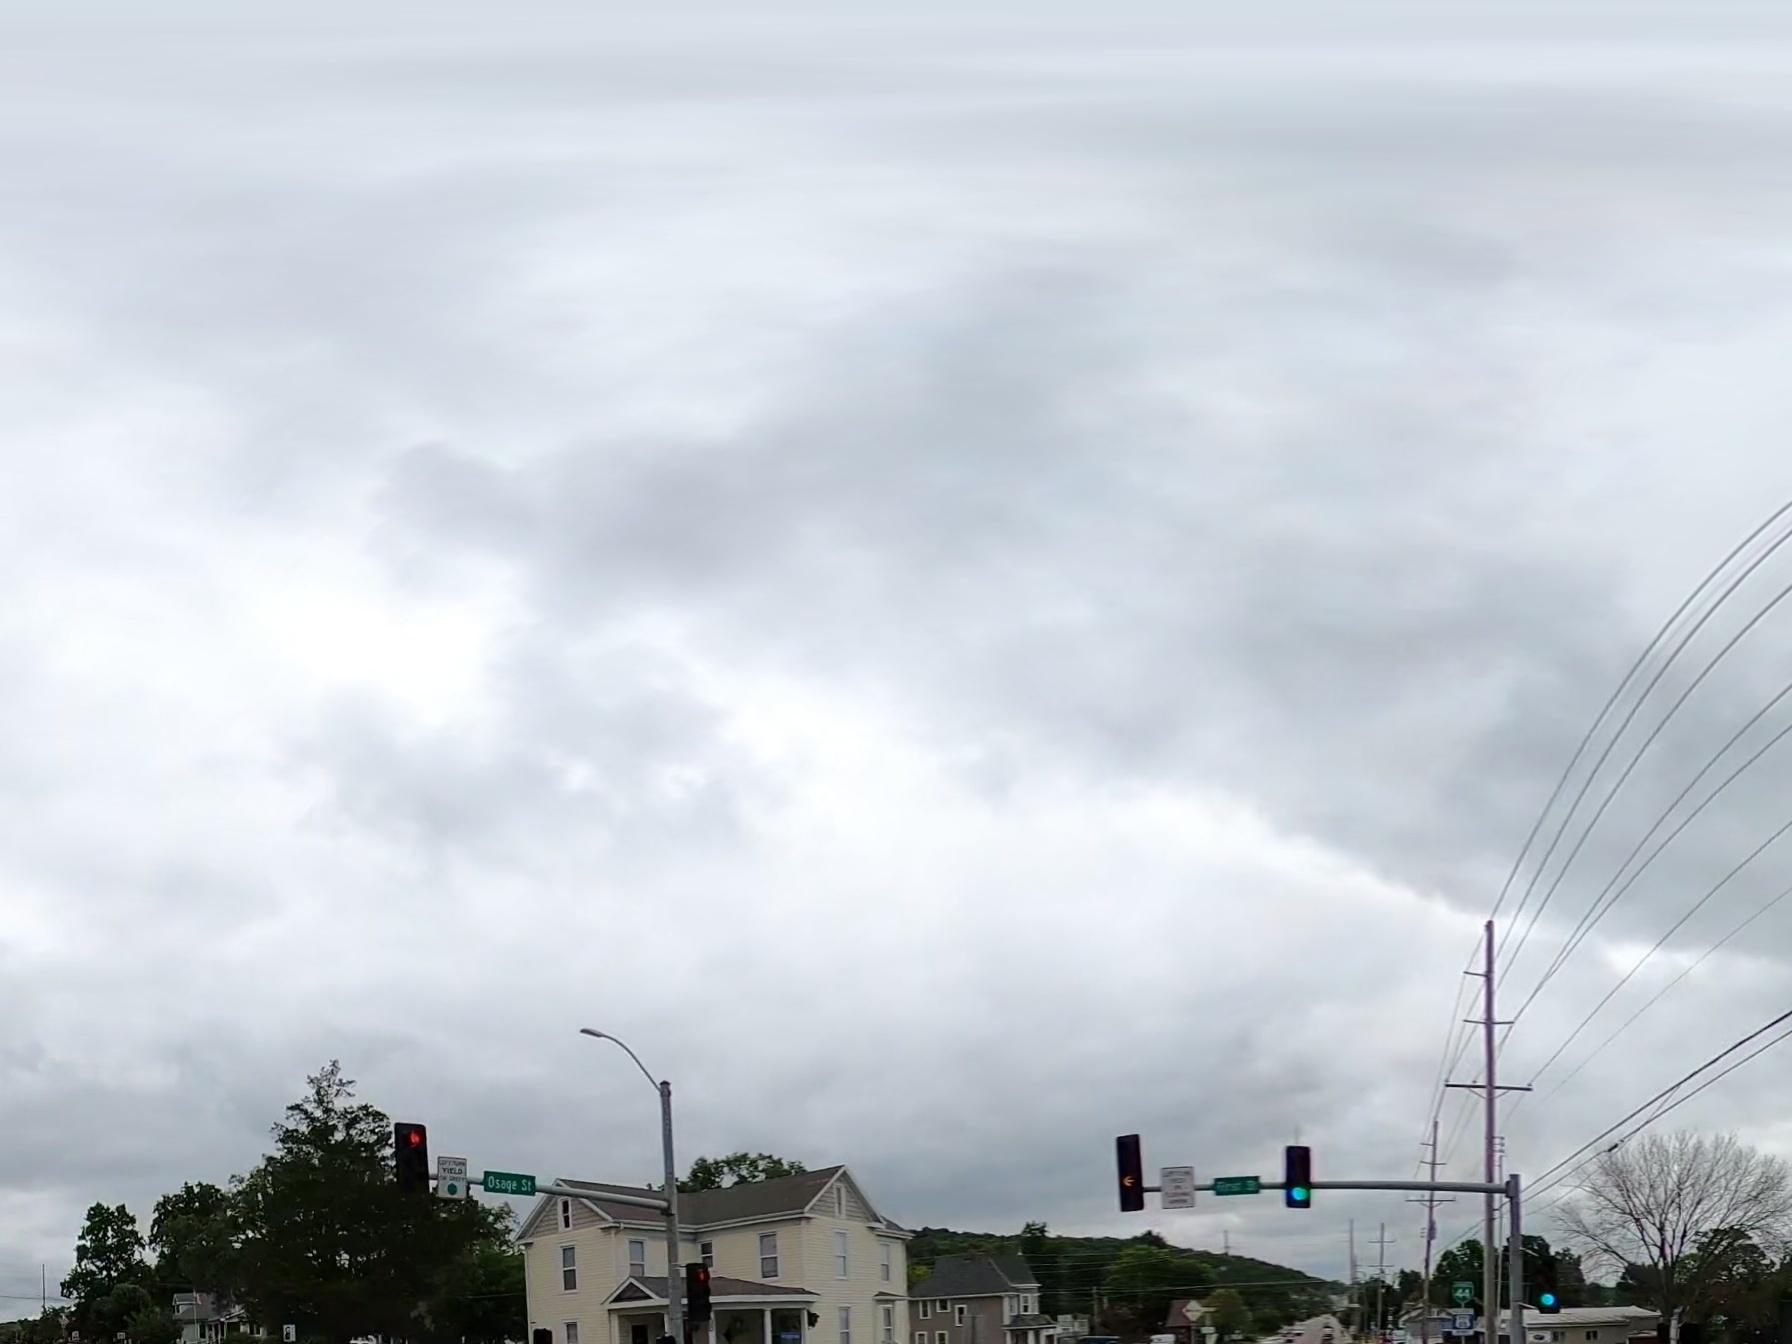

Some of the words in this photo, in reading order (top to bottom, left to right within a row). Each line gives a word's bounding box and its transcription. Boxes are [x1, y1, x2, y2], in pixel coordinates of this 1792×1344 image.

[442, 1167, 463, 1175] YIELD
[488, 1176, 517, 1193] Osage
[521, 1179, 532, 1192] St
